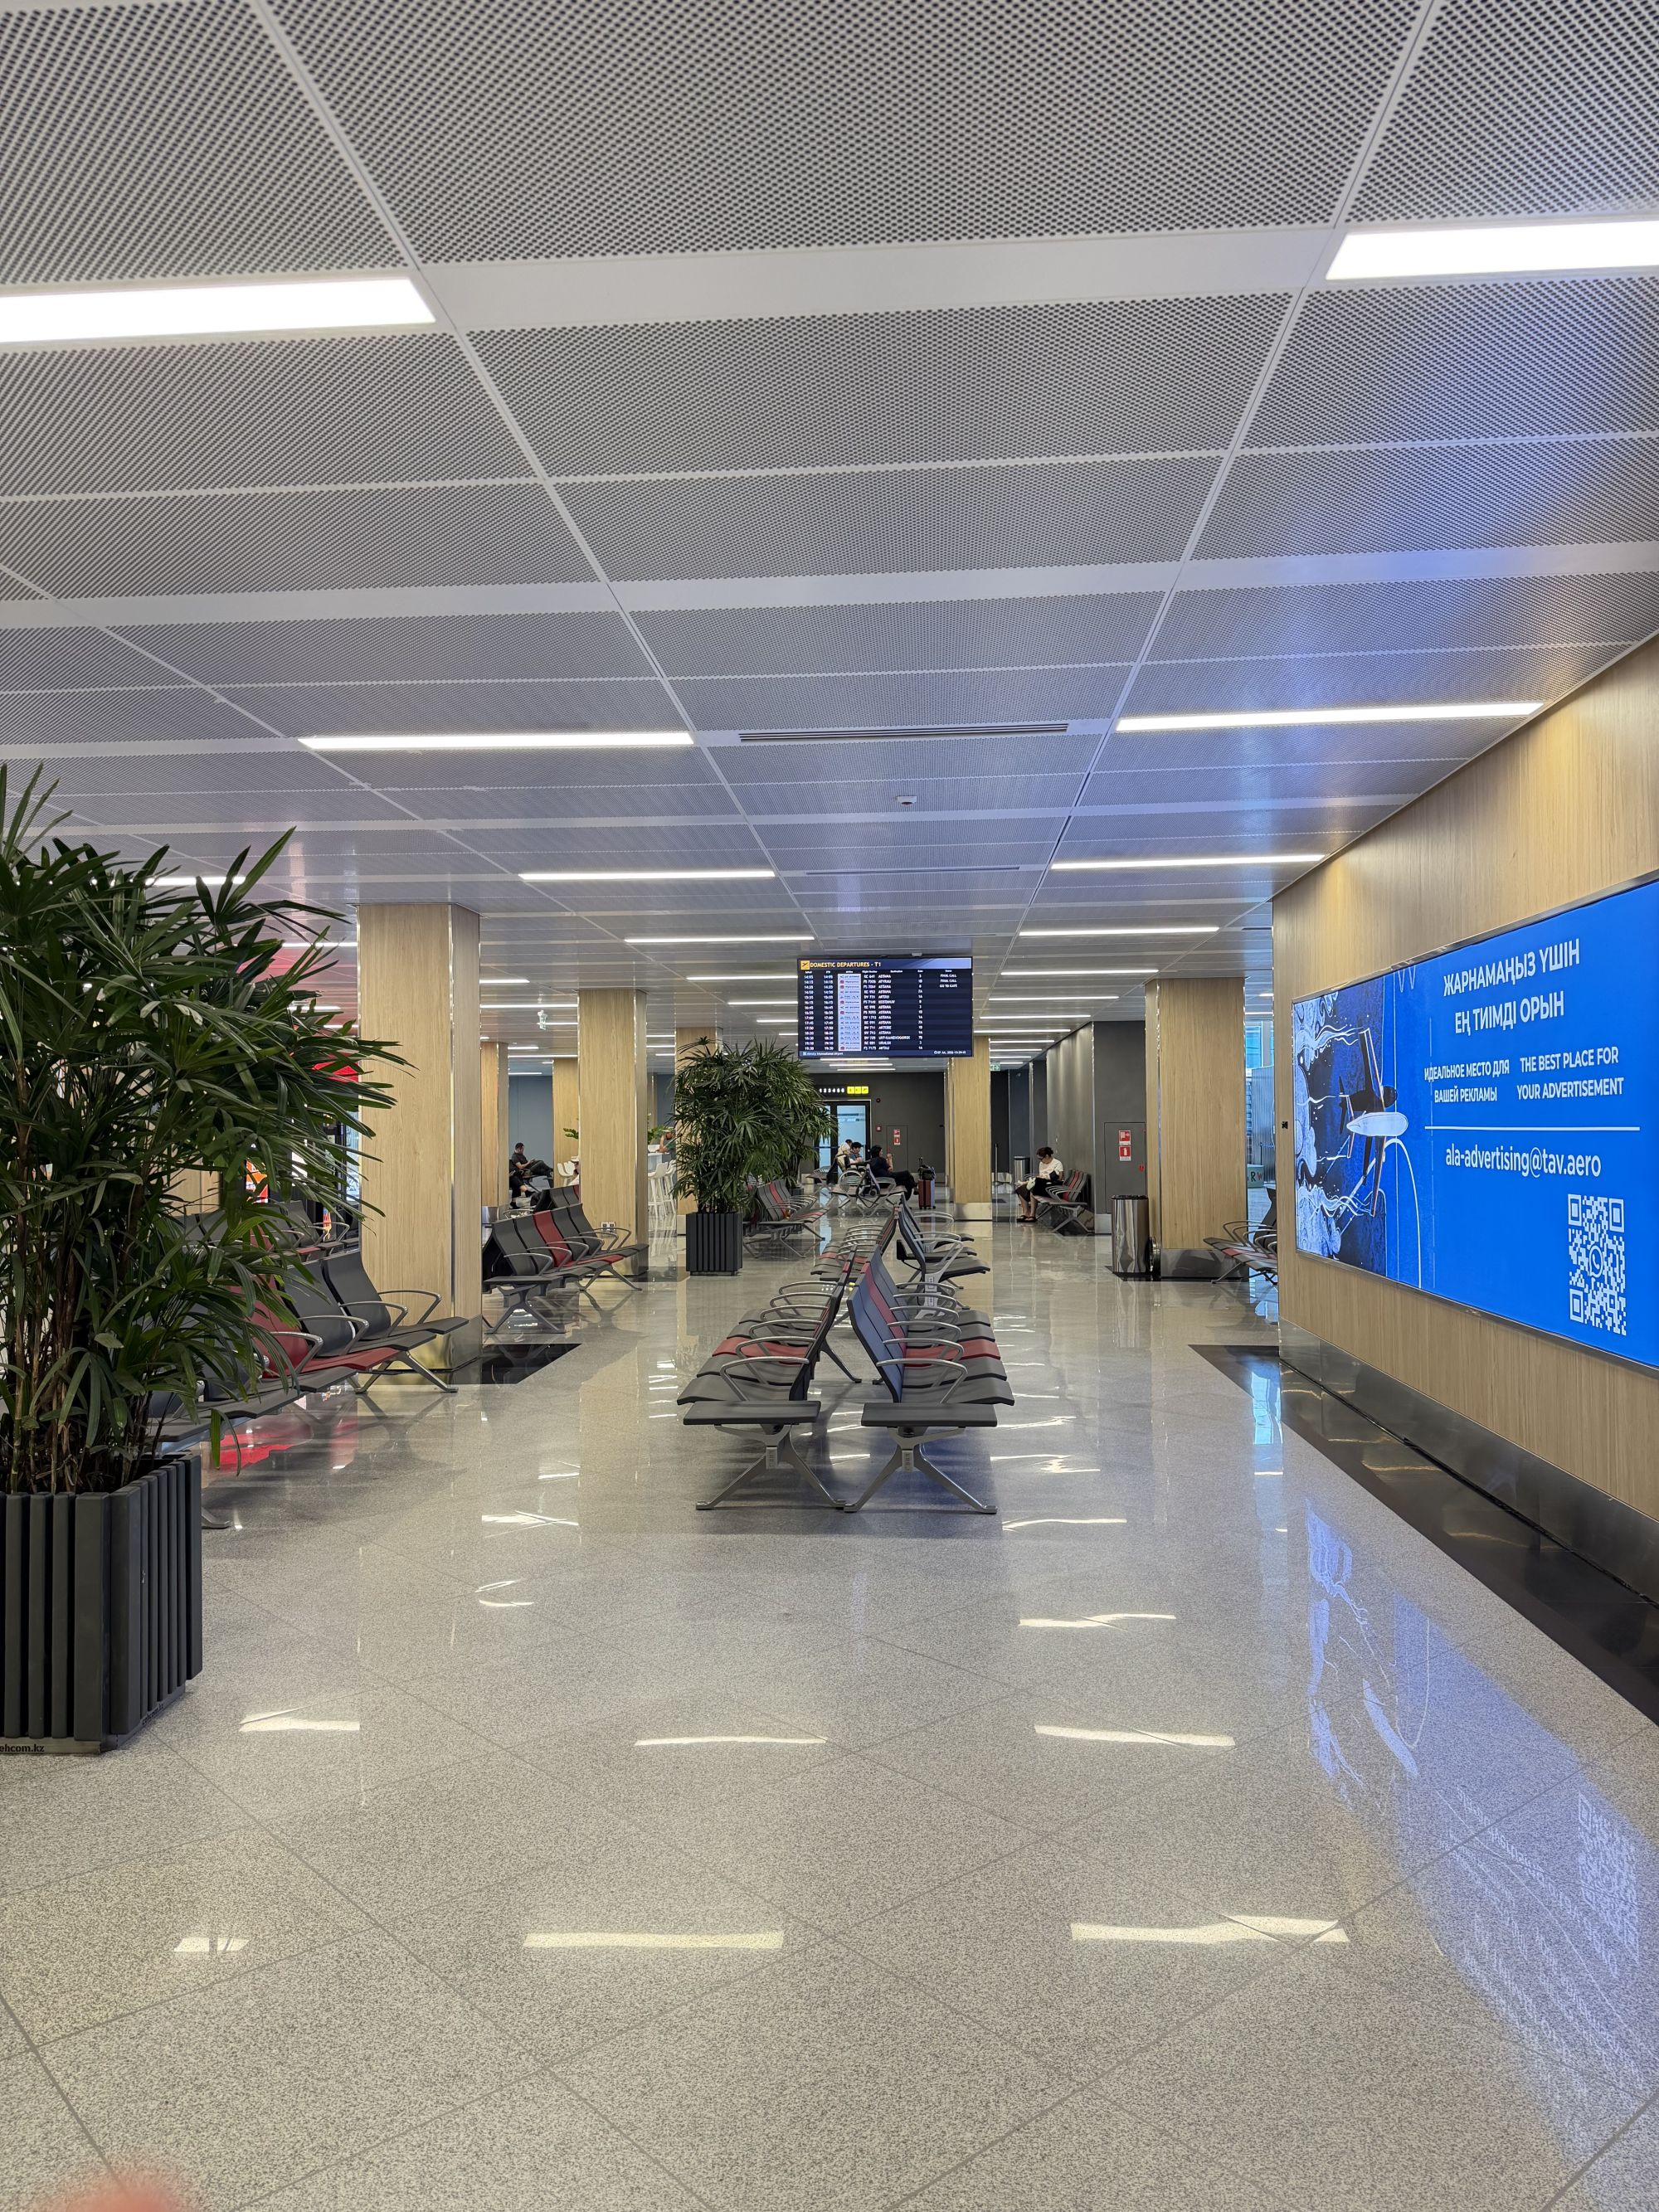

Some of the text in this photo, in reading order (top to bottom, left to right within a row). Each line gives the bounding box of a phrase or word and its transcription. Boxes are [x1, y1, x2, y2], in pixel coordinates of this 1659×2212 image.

[1443, 951, 1536, 997] ЖАРНАМАҢЫЗ
[1455, 990, 1565, 1037] ЕҢ ТИІМДІ ОРЫН
[1423, 1058, 1511, 1082] ИДЕАЛЬНОЕ МЕСТО ДЛЯ
[1520, 1046, 1619, 1072] THE BEST PLACE FOR
[1434, 1085, 1498, 1103] ВАШЕЙ РЕКЛАМЫ
[1516, 1077, 1625, 1100] YOUR ADVERTISEMENT
[1446, 1142, 1602, 1178] ala-advertising@tav.aero
